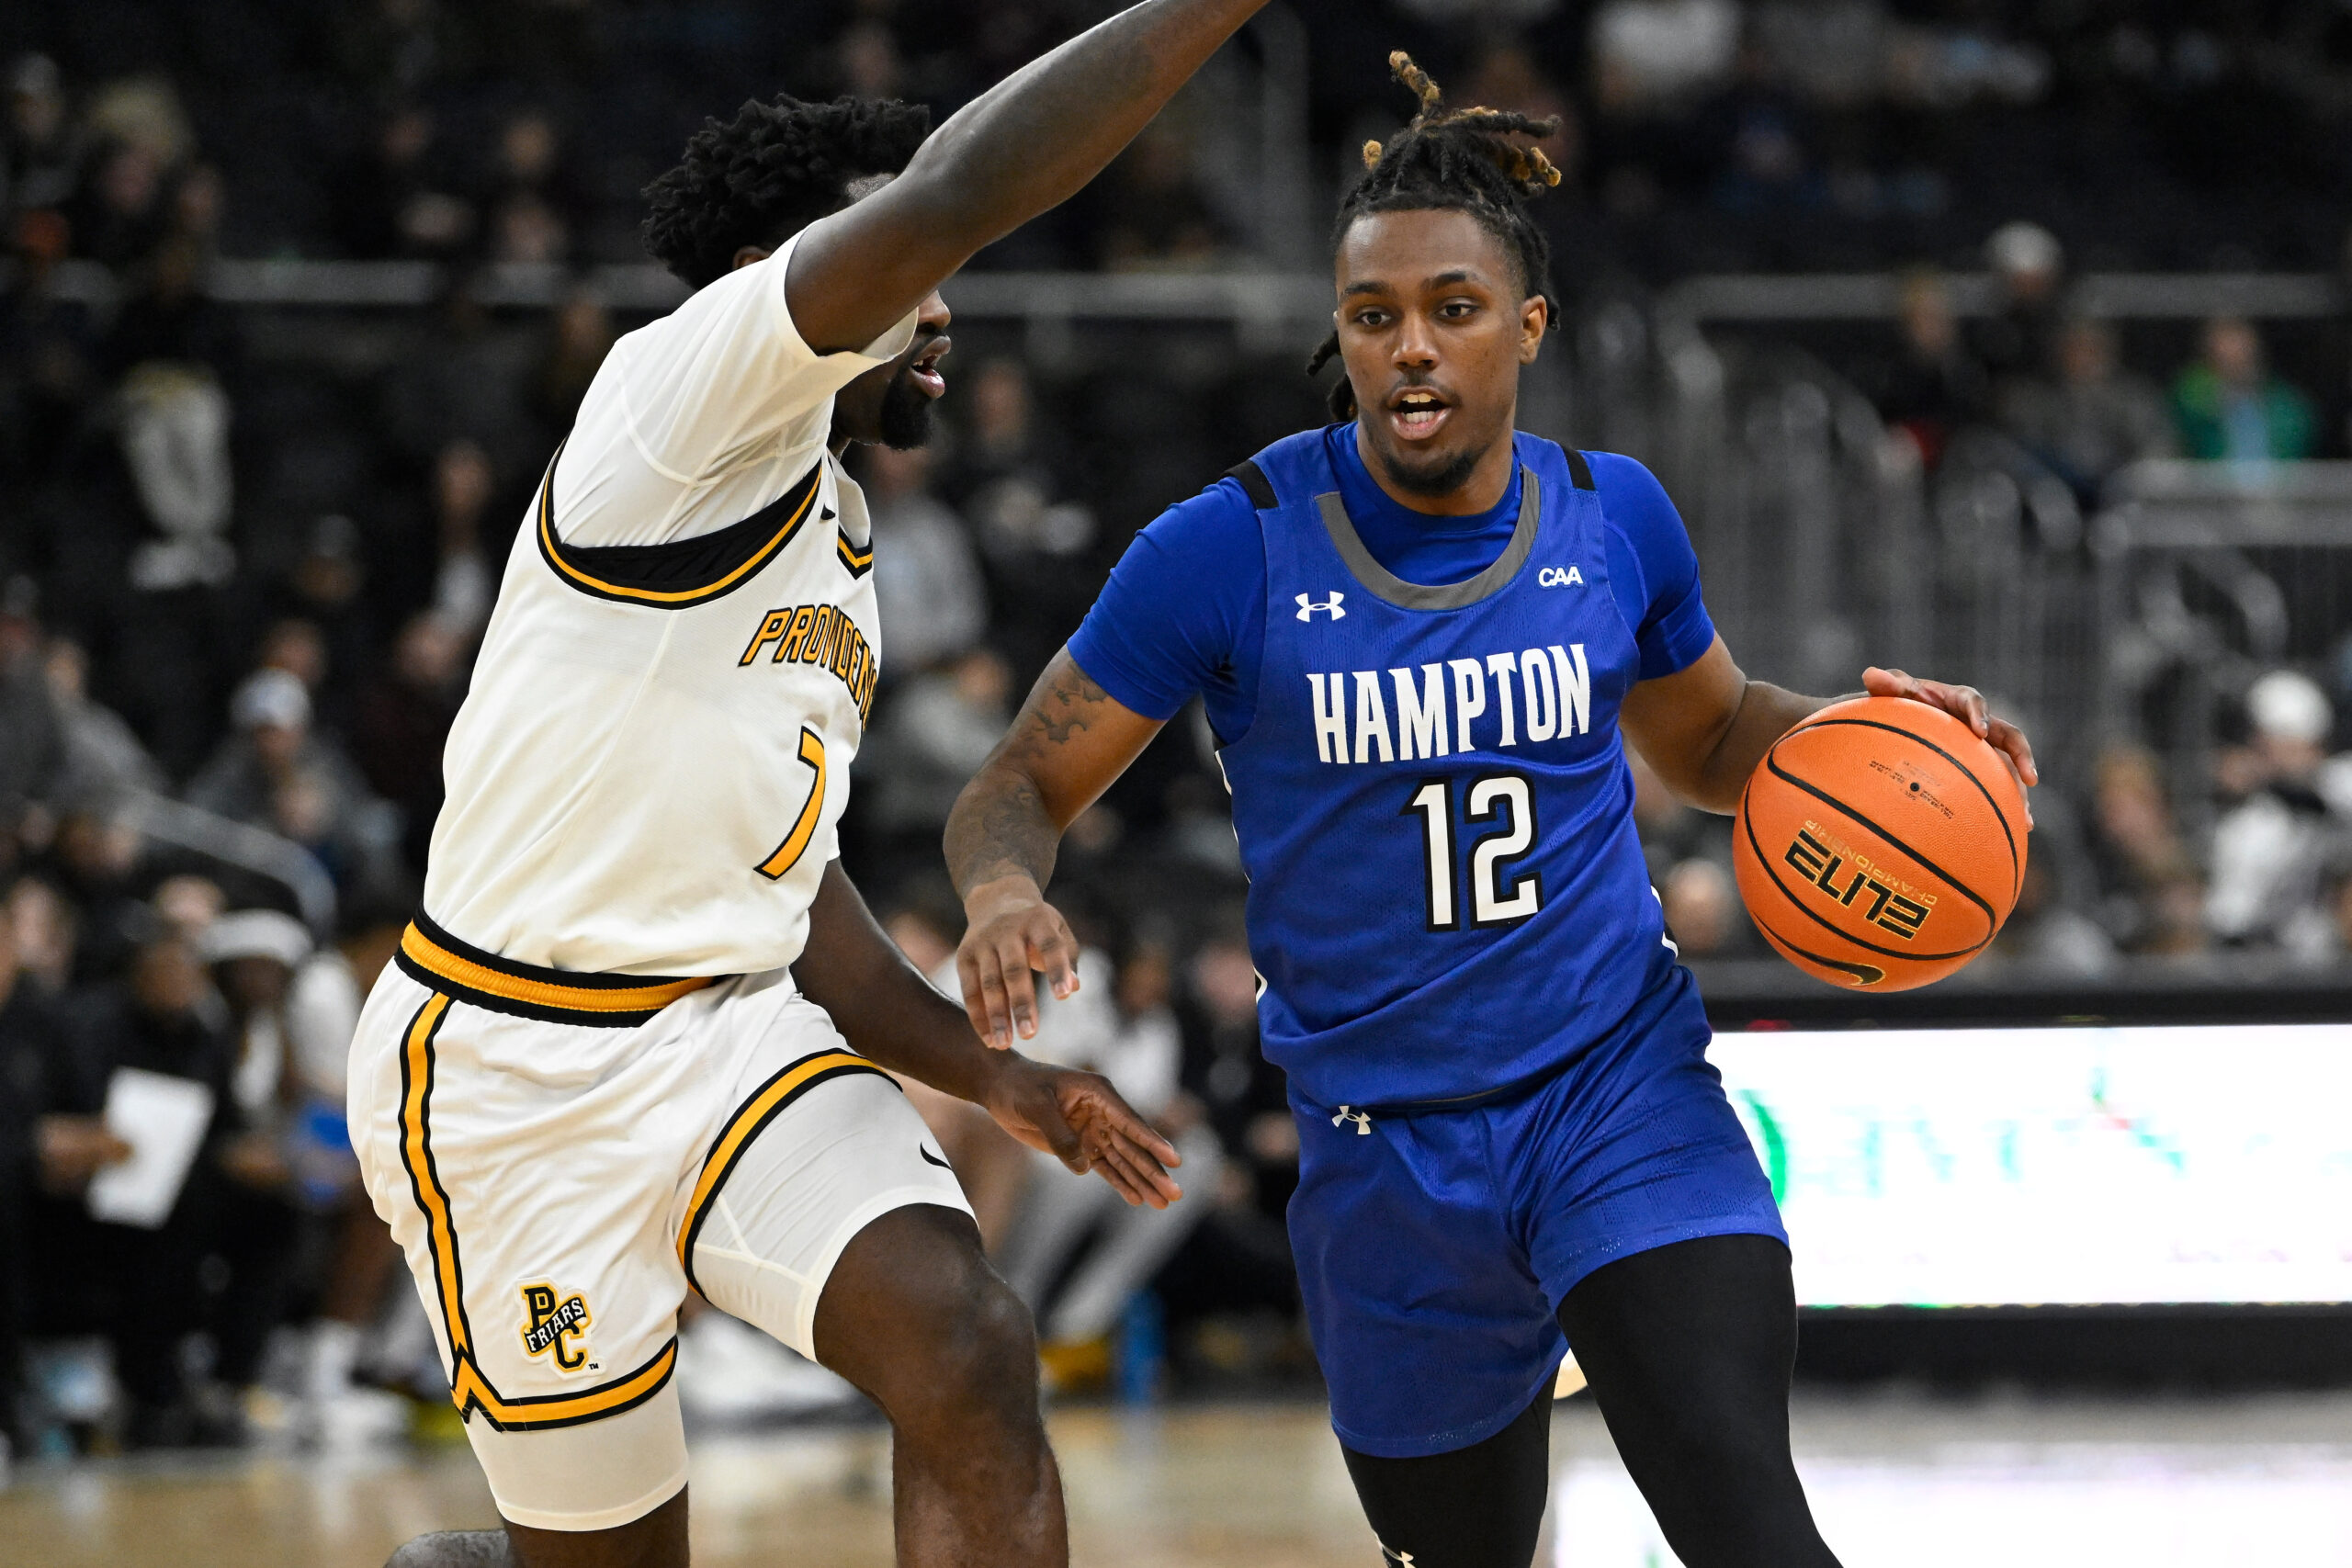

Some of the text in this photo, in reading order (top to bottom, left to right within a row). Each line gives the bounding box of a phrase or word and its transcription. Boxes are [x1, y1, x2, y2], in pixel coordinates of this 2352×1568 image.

[1538, 566, 1584, 587] CAA
[1306, 643, 1590, 764] HAMPTON
[1399, 770, 1544, 933] 12
[1784, 828, 1931, 941] ELITE
[526, 1299, 584, 1351] FRIARS
